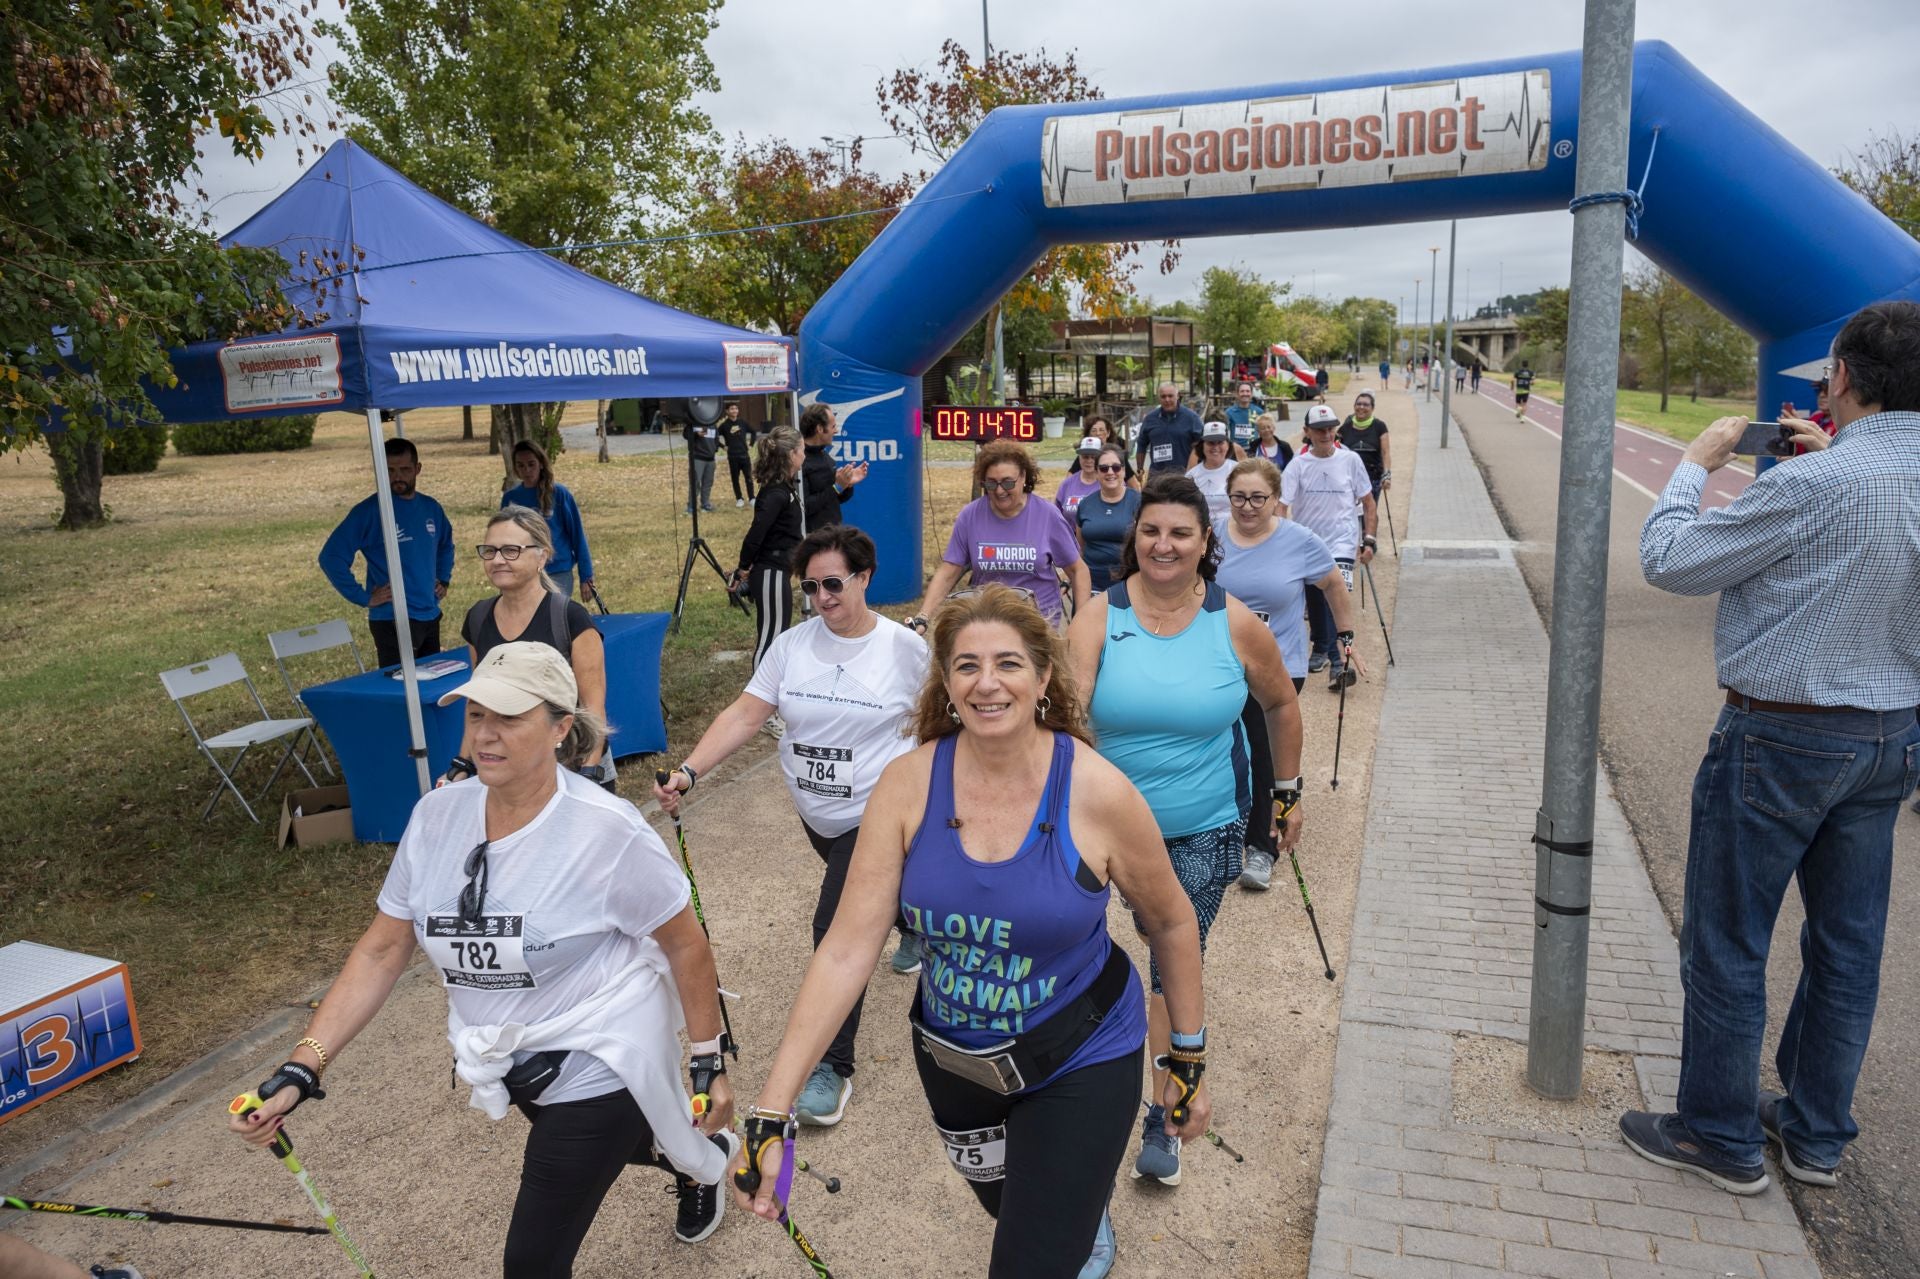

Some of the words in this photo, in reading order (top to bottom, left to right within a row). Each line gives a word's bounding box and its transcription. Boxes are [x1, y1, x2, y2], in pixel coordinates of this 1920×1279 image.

[1094, 96, 1485, 182] Pulsaciones.net
[238, 355, 323, 375] Pulsaciones.net
[390, 342, 649, 384] www.pulsaciones.net
[937, 410, 1034, 438] 00:14:76
[978, 561, 1035, 571] WALKING
[996, 546, 1037, 561] NORDIC
[786, 690, 804, 698] Nordic
[806, 692, 833, 702] Walking
[834, 696, 883, 710] Extremadura
[806, 760, 836, 782] 784
[925, 909, 1012, 949] LOVE
[450, 941, 502, 970] 782
[929, 940, 1033, 982] DREAM
[475, 973, 528, 983] EXTREMADURA
[931, 955, 1058, 1013] NORWALK
[21, 1013, 77, 1086] 3
[31, 1201, 76, 1213] VIPOLE
[795, 1232, 815, 1260] VIPOLE
